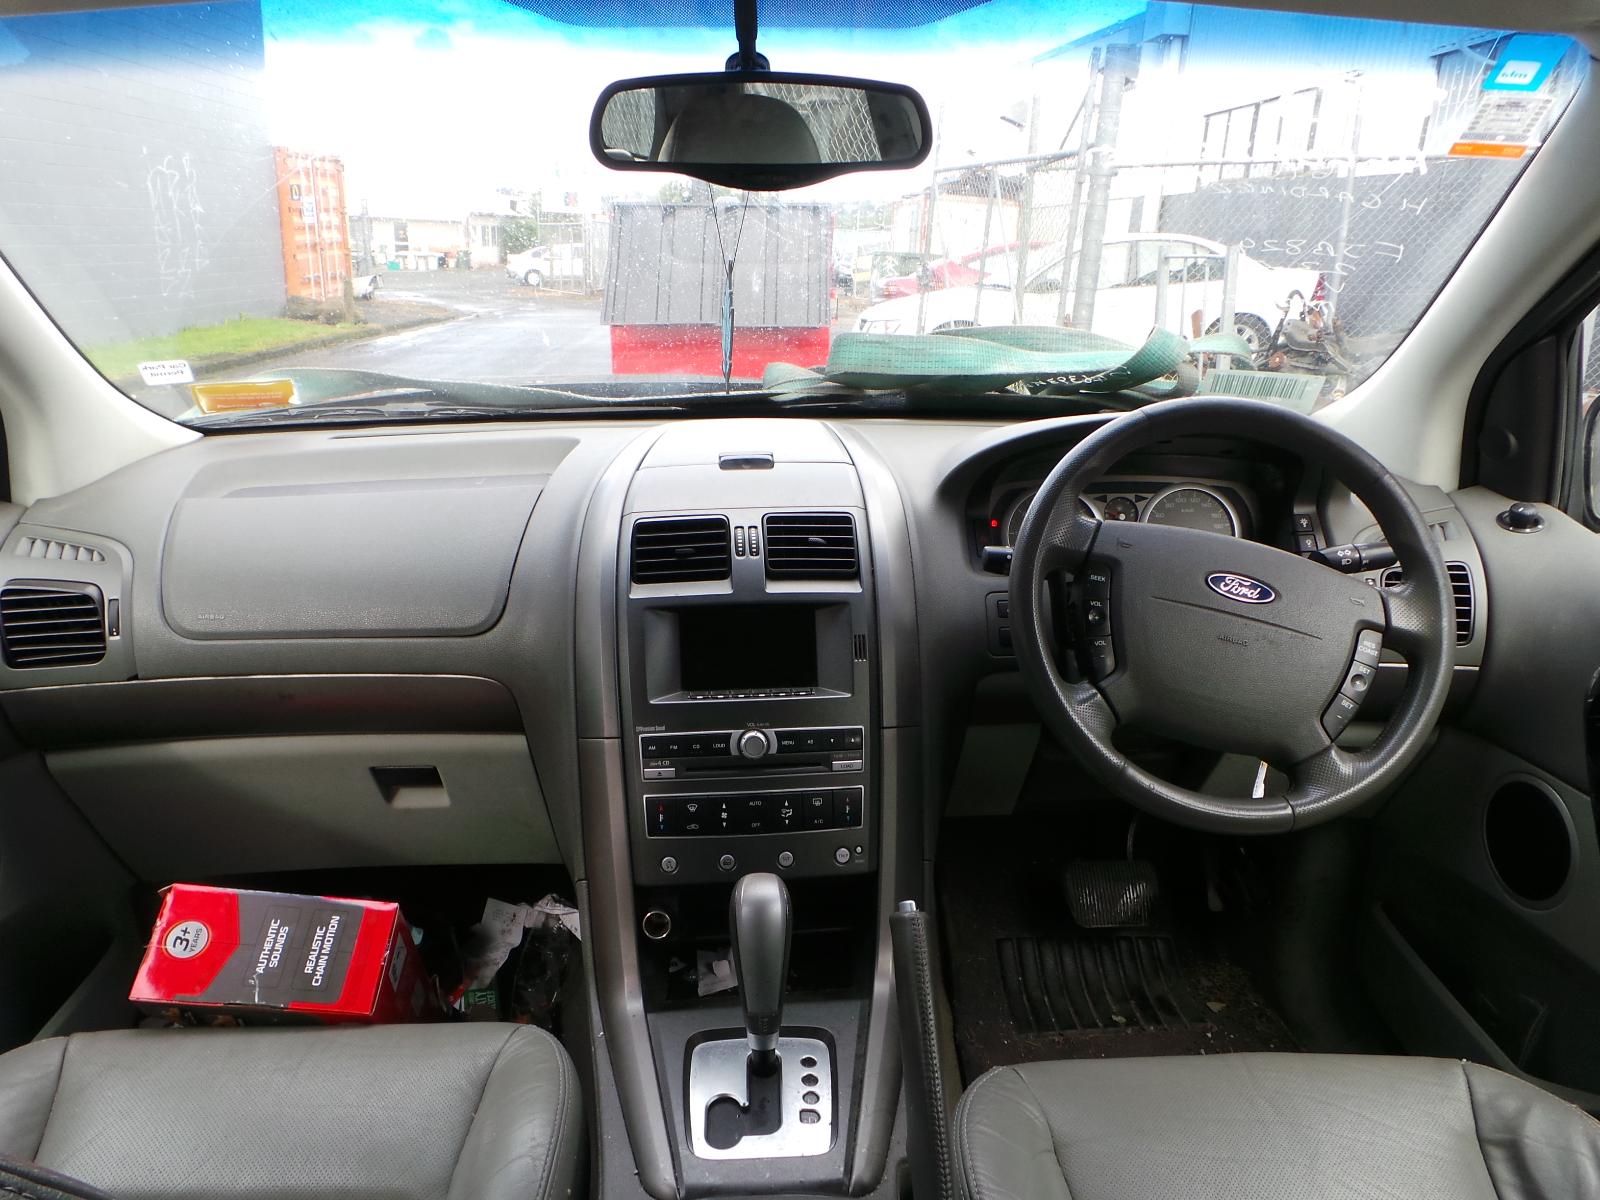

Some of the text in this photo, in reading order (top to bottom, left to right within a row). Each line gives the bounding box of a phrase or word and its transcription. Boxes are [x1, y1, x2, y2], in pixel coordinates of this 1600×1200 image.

[1090, 574, 1106, 582] SEEK
[1220, 576, 1262, 599] Ford
[173, 926, 191, 952] 3+
[189, 928, 203, 953] YEARS
[255, 918, 280, 974] AUTHENTIC
[268, 926, 289, 968] SOUNDS
[304, 925, 326, 974] REALISTIC
[311, 915, 340, 987] CHAIN MOTION
